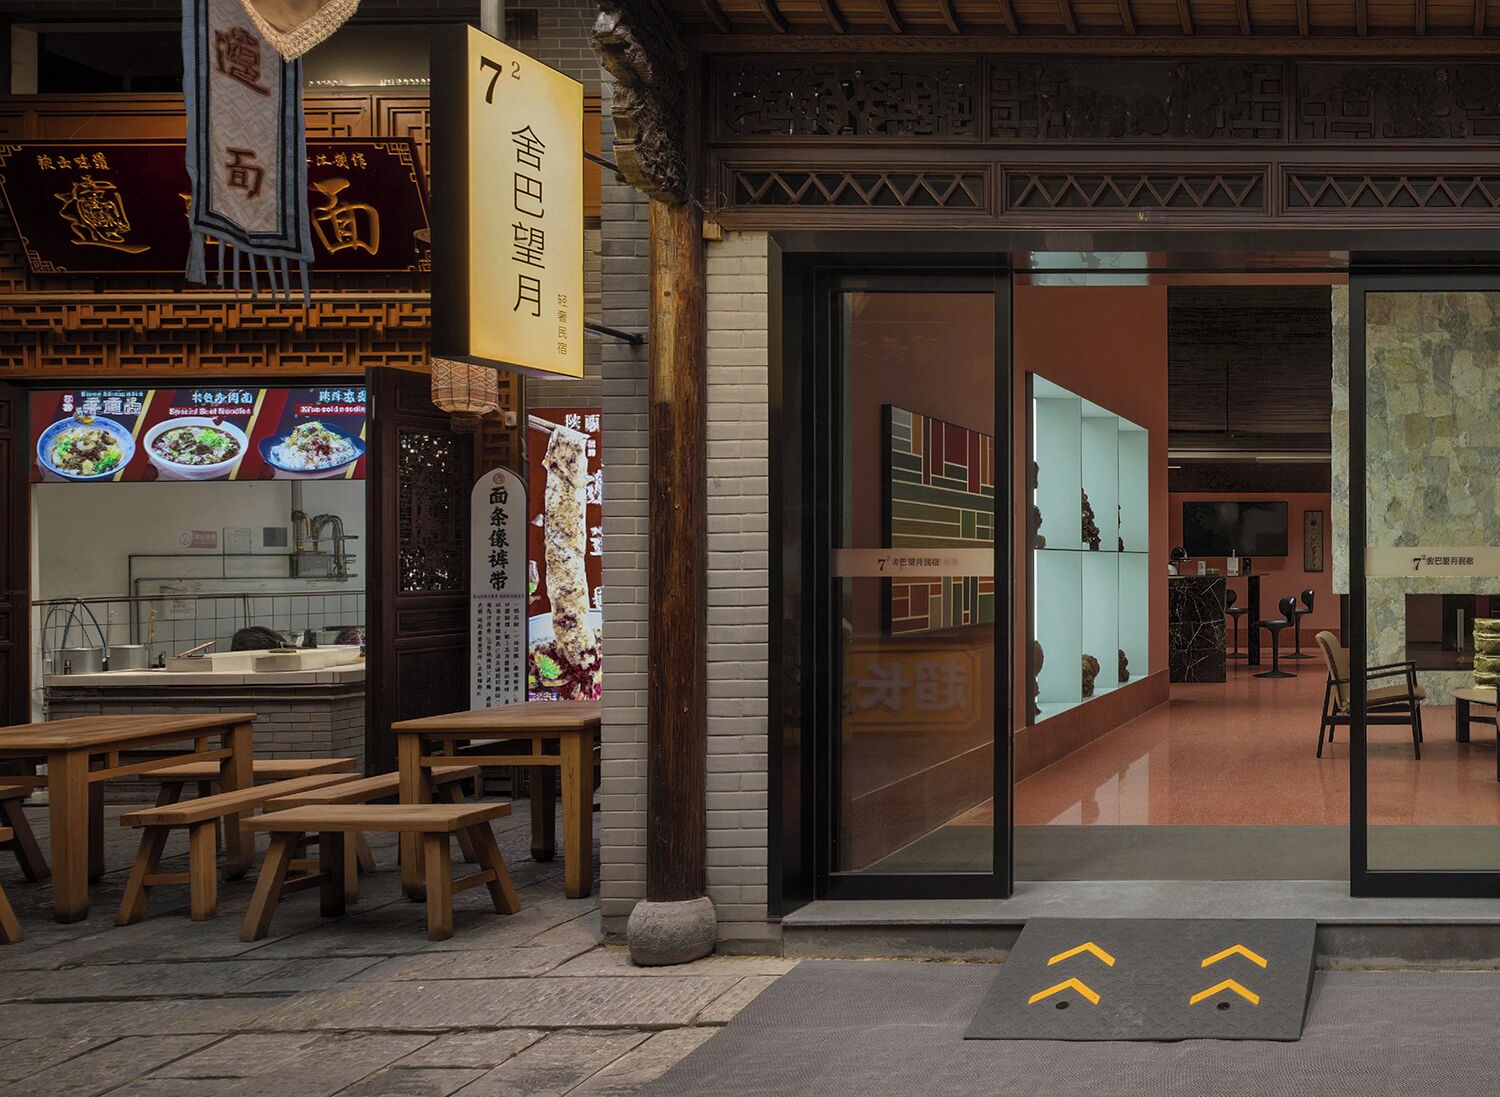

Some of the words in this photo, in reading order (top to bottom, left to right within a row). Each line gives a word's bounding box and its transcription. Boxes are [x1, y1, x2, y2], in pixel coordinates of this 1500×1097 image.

[511, 124, 546, 317] 舍巴望月
[488, 485, 510, 591] 面条像裤带
